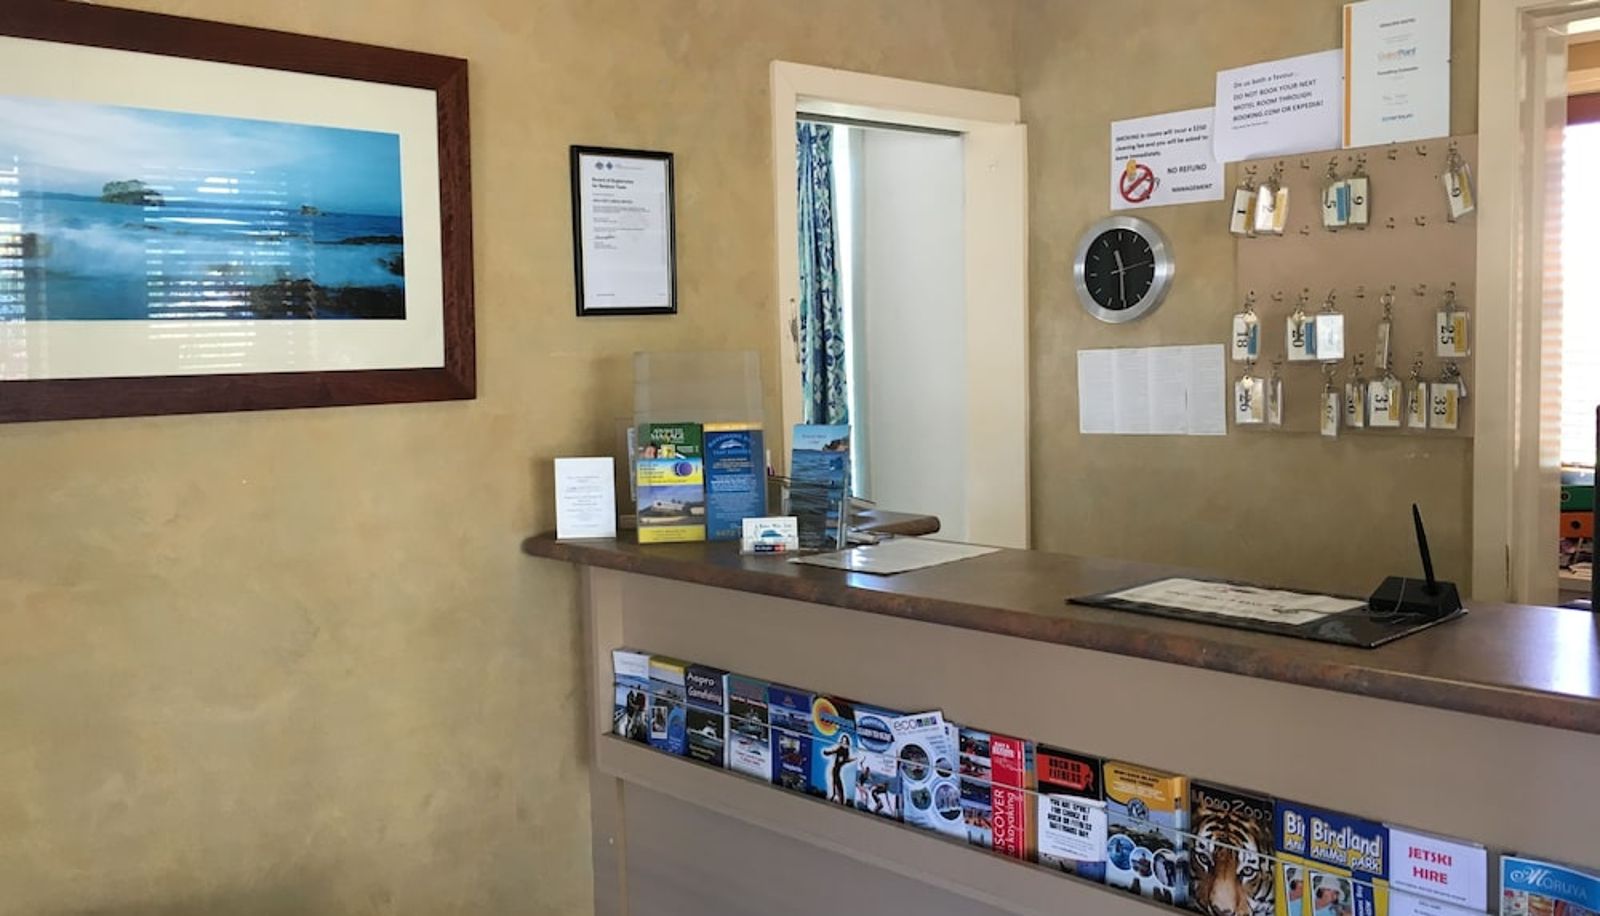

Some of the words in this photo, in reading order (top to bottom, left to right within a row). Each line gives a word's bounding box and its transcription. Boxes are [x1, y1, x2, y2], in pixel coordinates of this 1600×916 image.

[1244, 90, 1258, 98] NOT
[1260, 87, 1278, 96] BOOK
[1280, 83, 1298, 92] YOUR
[1299, 79, 1316, 88] NEXT
[1233, 102, 1255, 111] MOTEL
[1256, 98, 1278, 107] ROOM
[1279, 92, 1312, 102] THROUGH
[1233, 109, 1280, 122] BOOKING.COM
[1179, 164, 1207, 173] REFUND
[1172, 183, 1213, 192] MANAGEMENT
[1237, 332, 1248, 348] 18
[1292, 330, 1304, 348] 20
[1440, 325, 1455, 344] 25
[1240, 394, 1252, 412] 26
[1375, 394, 1388, 412] 31
[1434, 396, 1447, 415] 33
[894, 719, 916, 731] eco
[1314, 818, 1380, 858] Birdland
[1408, 846, 1452, 866] JETSKI
[1413, 866, 1448, 884] HIRE
